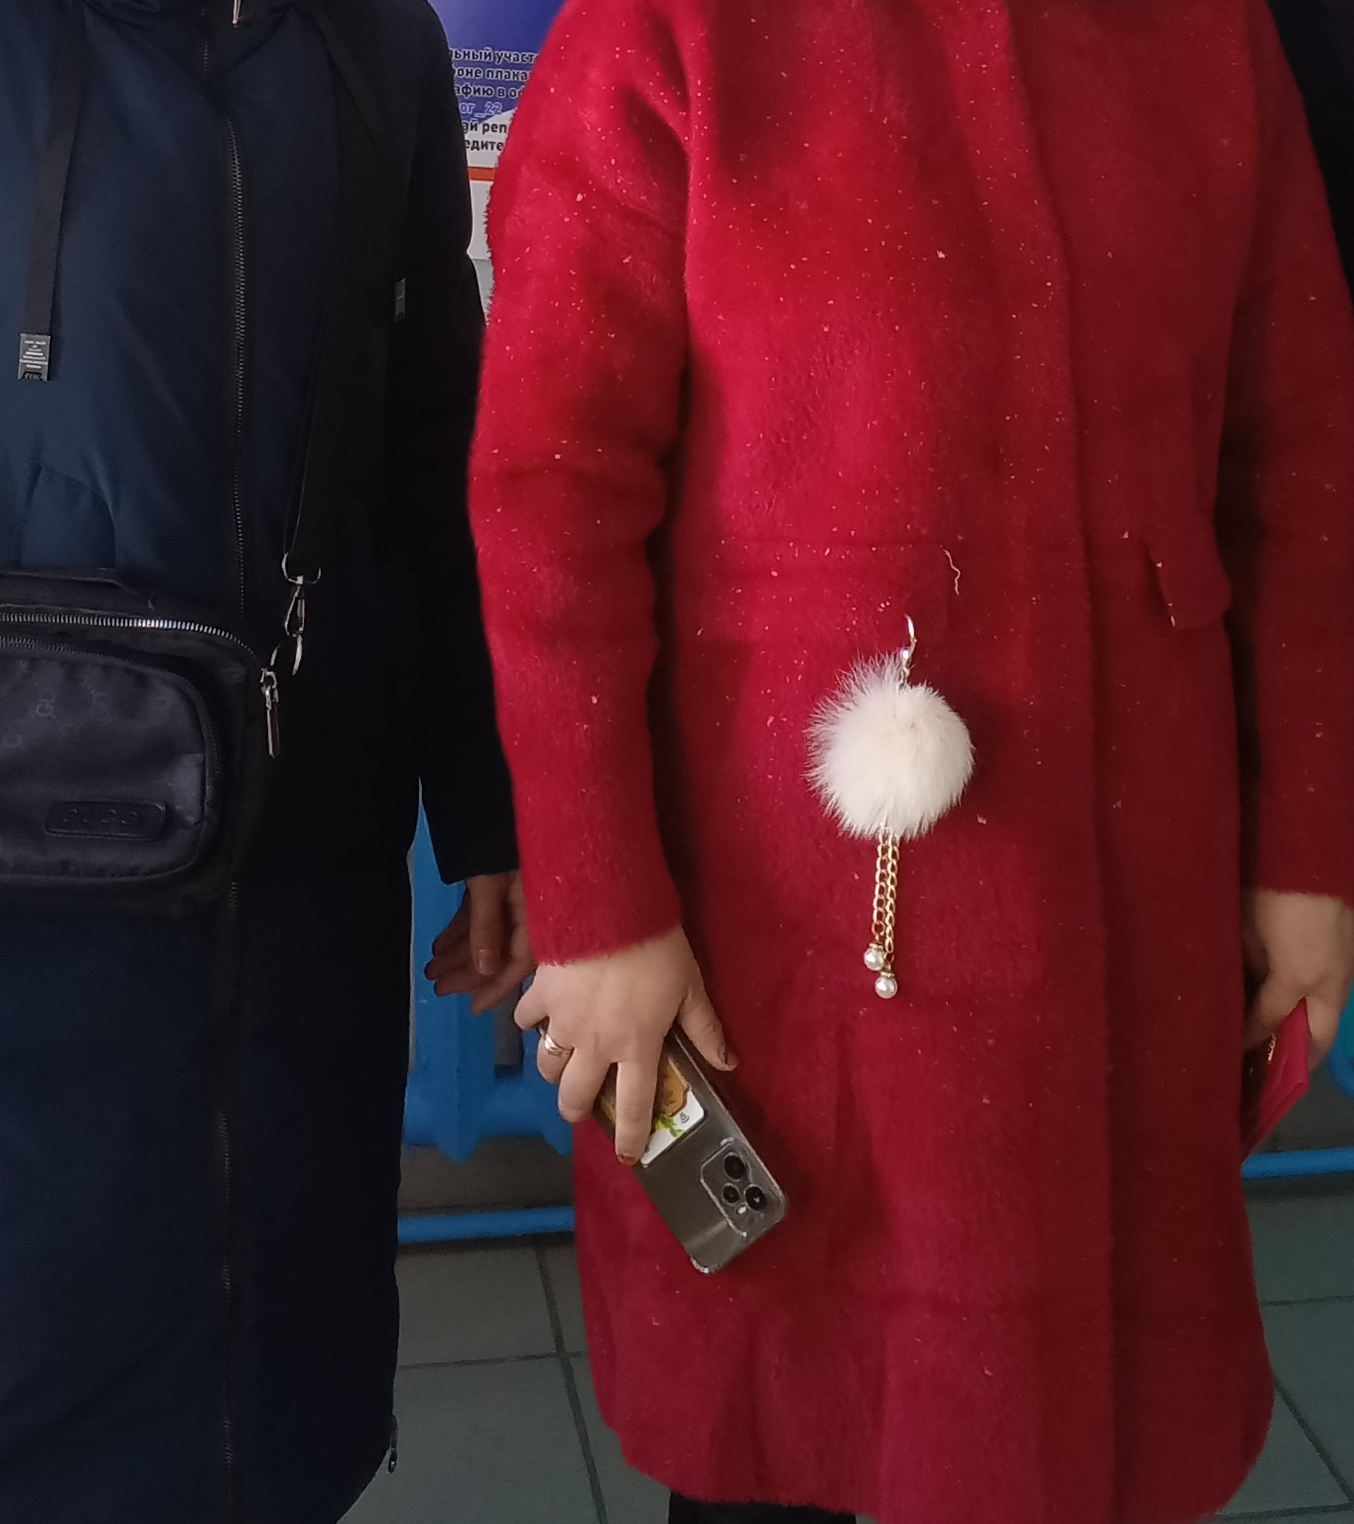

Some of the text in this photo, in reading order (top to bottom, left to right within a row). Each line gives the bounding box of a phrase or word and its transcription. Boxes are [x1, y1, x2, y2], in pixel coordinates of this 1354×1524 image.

[498, 88, 505, 97] в
[509, 88, 523, 98] о
[482, 123, 507, 134] реп
